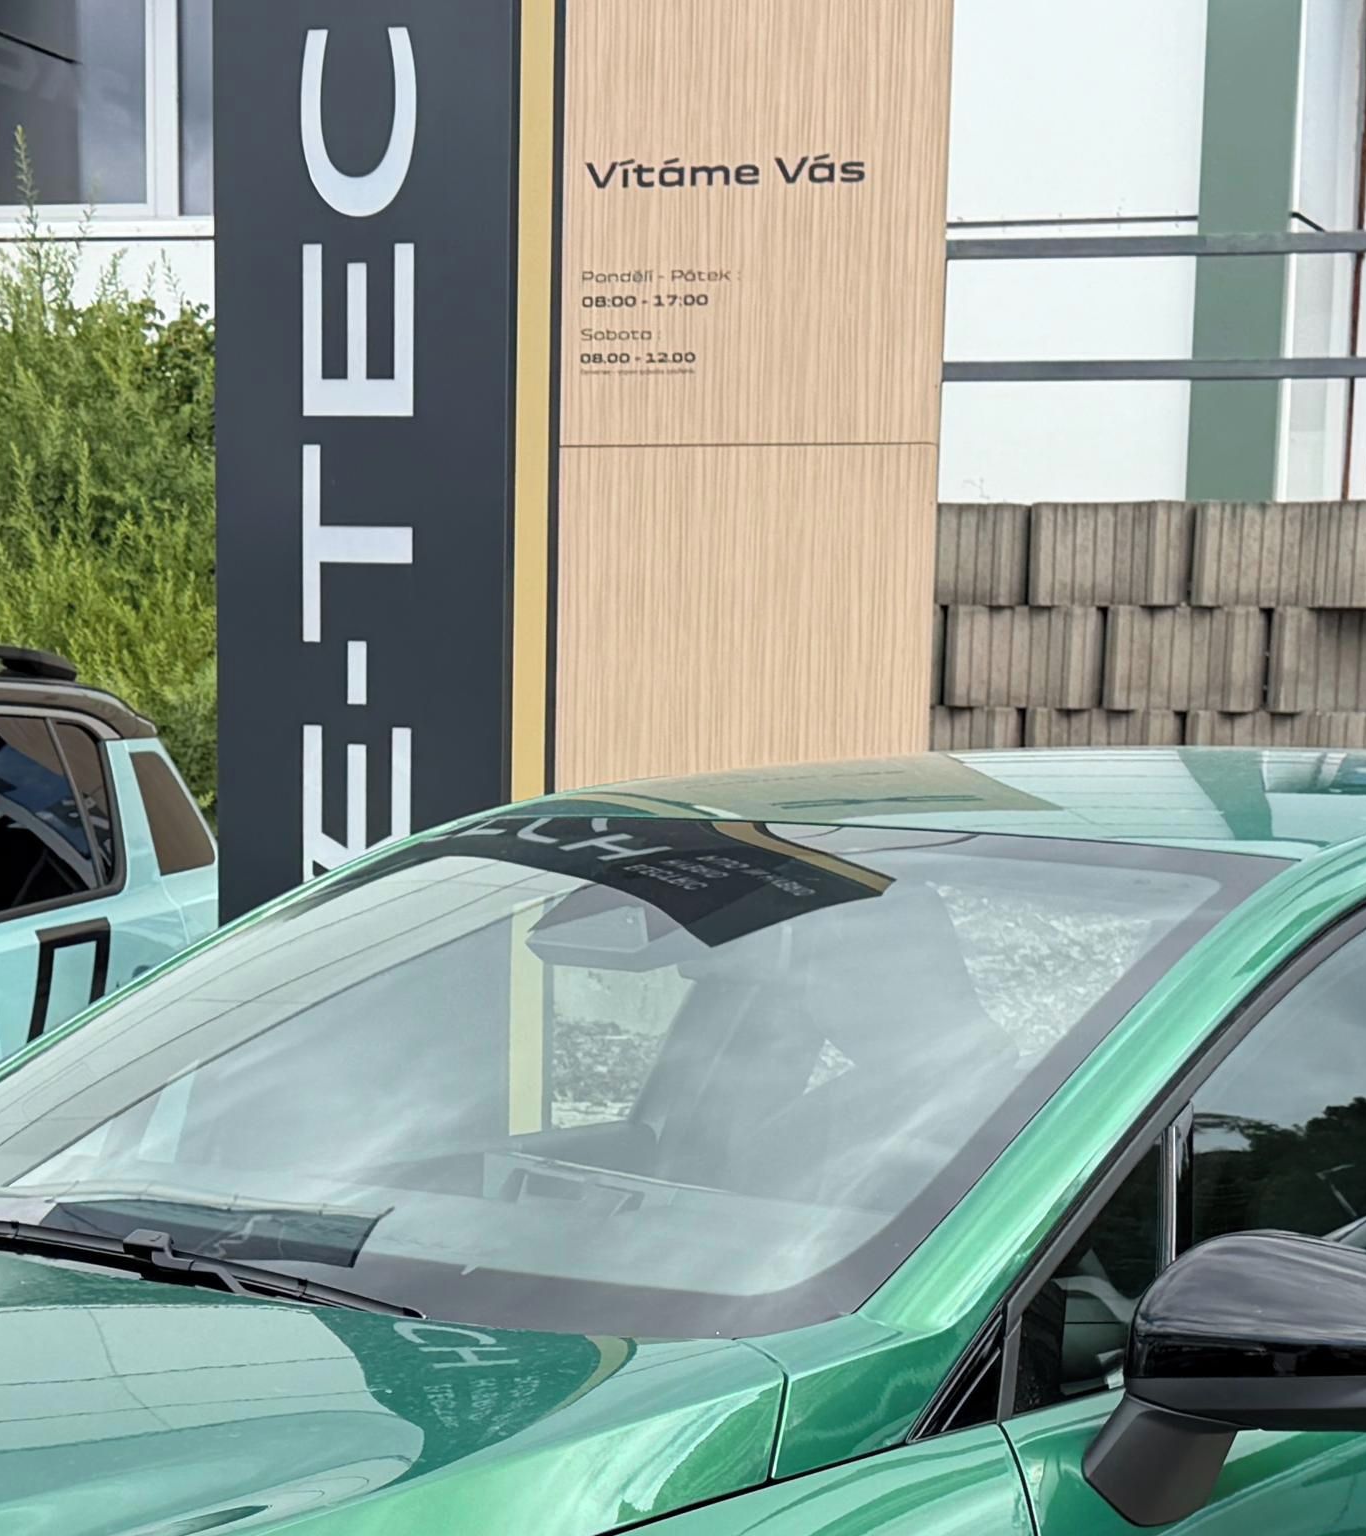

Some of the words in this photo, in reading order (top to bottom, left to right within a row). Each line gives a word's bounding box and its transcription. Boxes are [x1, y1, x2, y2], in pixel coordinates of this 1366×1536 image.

[585, 157, 760, 190] Vítáme
[775, 153, 867, 185] Vás
[581, 295, 637, 308] 08:00
[653, 293, 709, 307] 17:00
